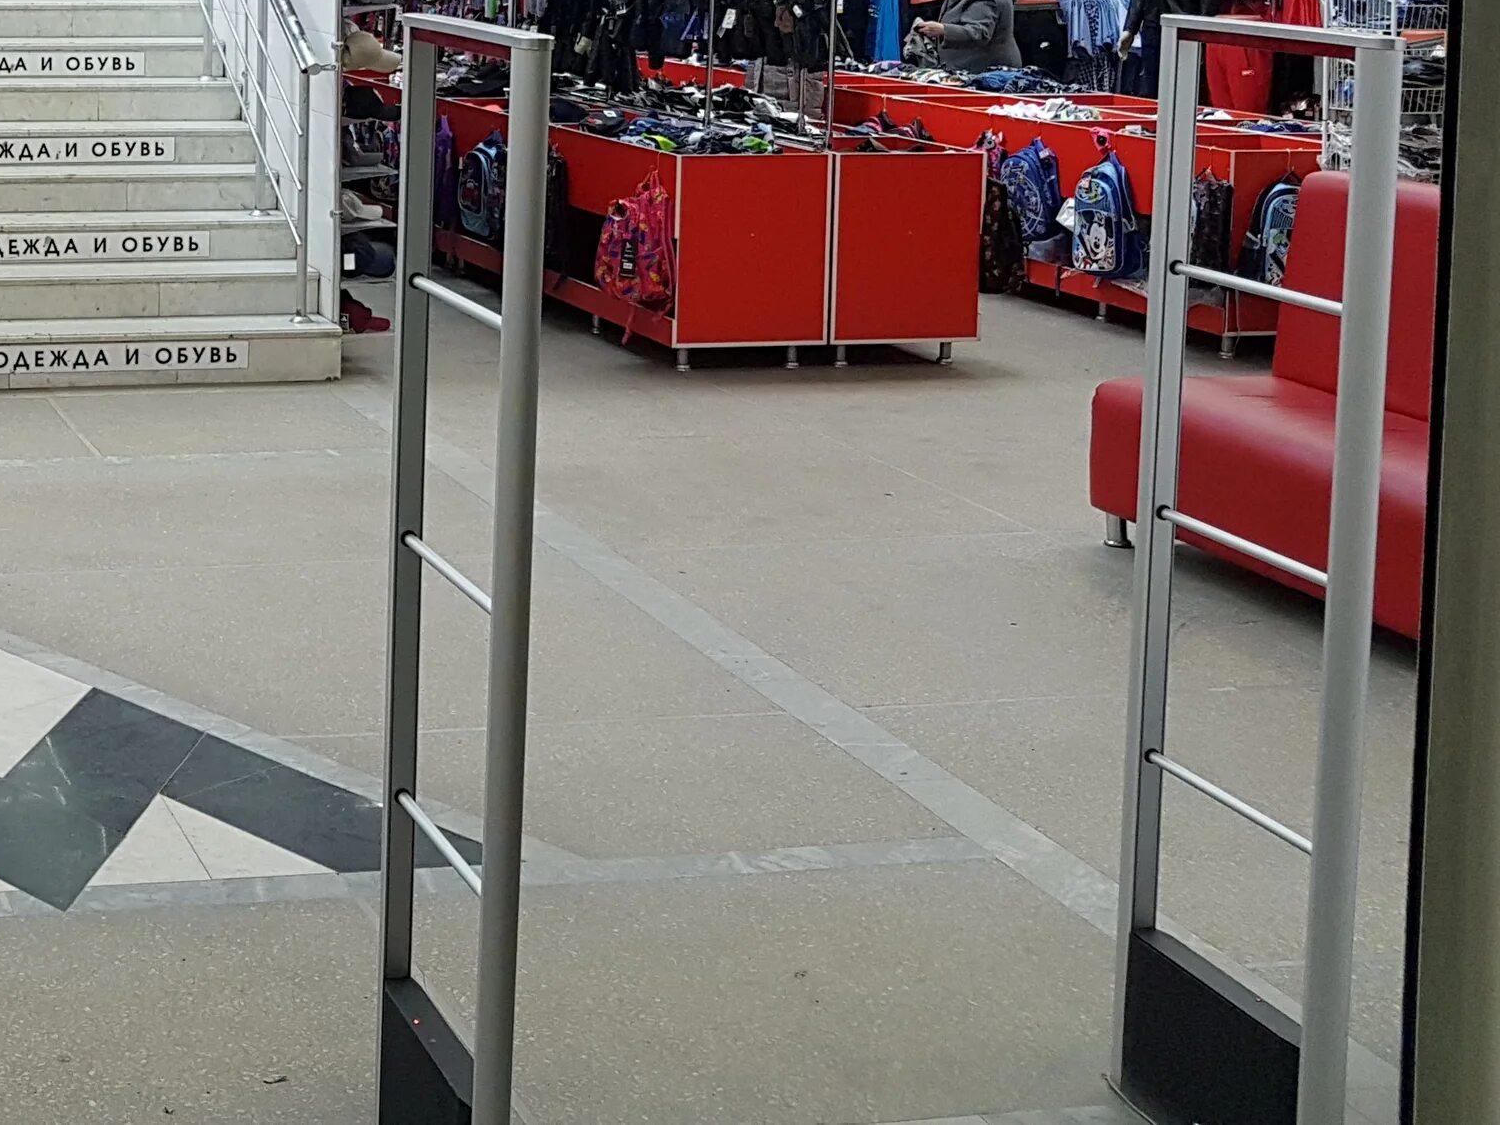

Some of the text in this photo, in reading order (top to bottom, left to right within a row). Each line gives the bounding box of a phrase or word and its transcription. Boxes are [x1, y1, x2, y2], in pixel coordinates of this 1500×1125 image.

[42, 56, 53, 71] И
[66, 56, 136, 71] ОБУВЬ
[64, 142, 78, 159] И
[92, 140, 166, 157] ОБУВЬ
[93, 236, 107, 255] И
[122, 235, 199, 254] ОБУВЬ
[125, 348, 140, 366] И
[155, 346, 238, 365] ОБУВЬ
